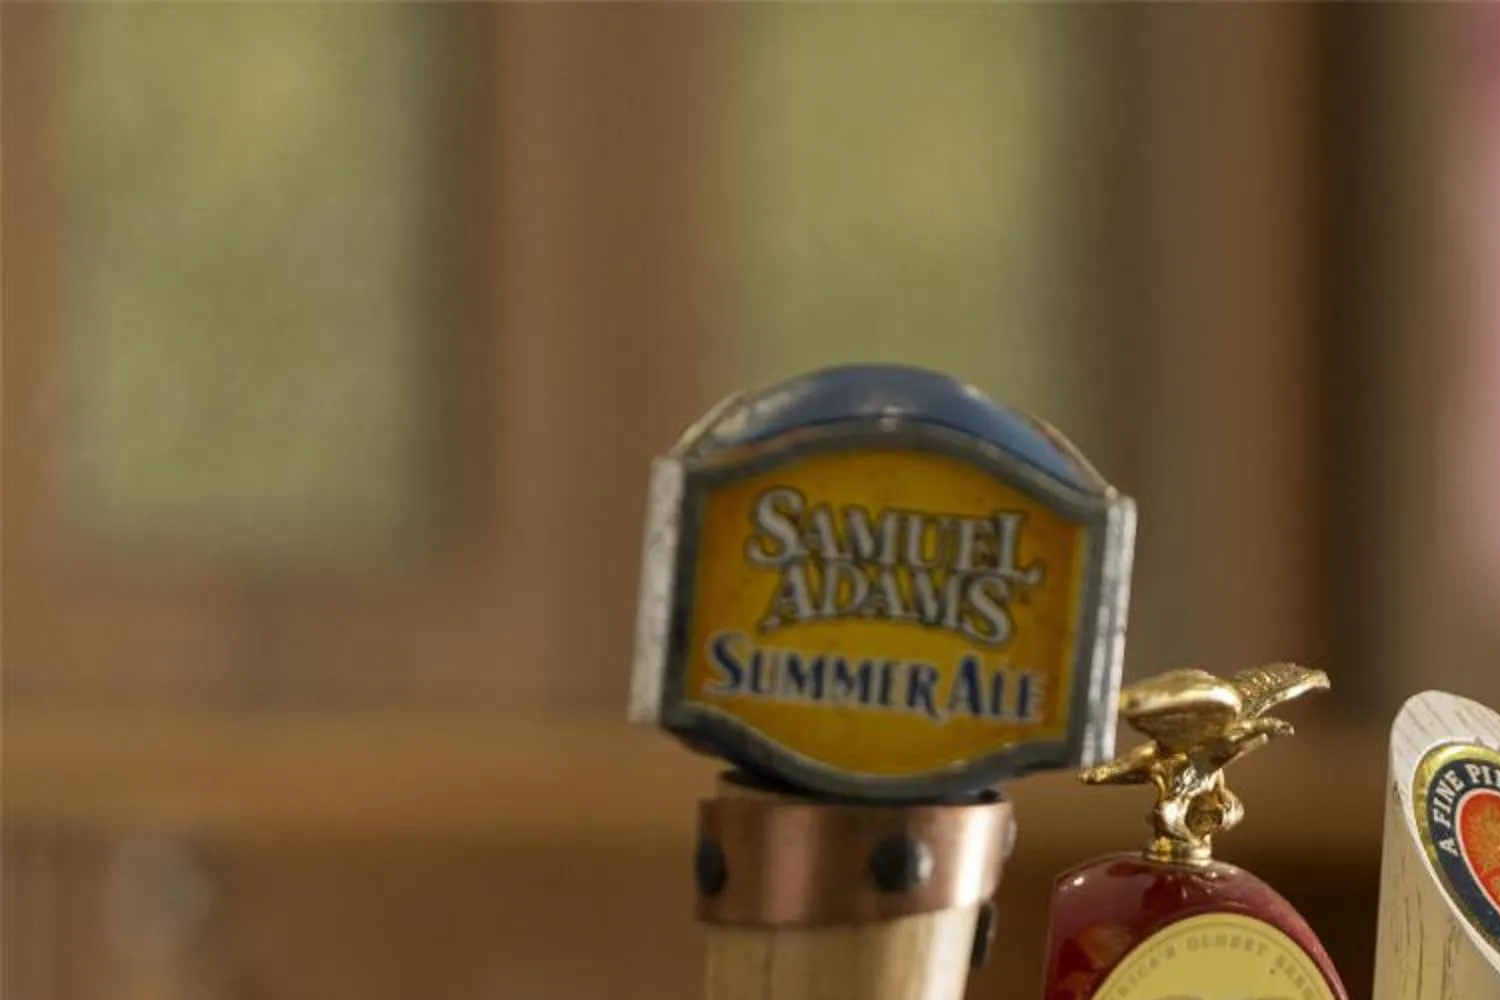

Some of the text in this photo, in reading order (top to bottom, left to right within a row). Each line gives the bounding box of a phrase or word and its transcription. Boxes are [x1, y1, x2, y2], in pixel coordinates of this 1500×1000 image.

[749, 486, 1047, 584] SAMUEL
[761, 556, 1014, 645] ADAMS
[704, 630, 1045, 724] SUMMER ALE
[1433, 768, 1466, 829] FINE
[1438, 837, 1459, 858] A
